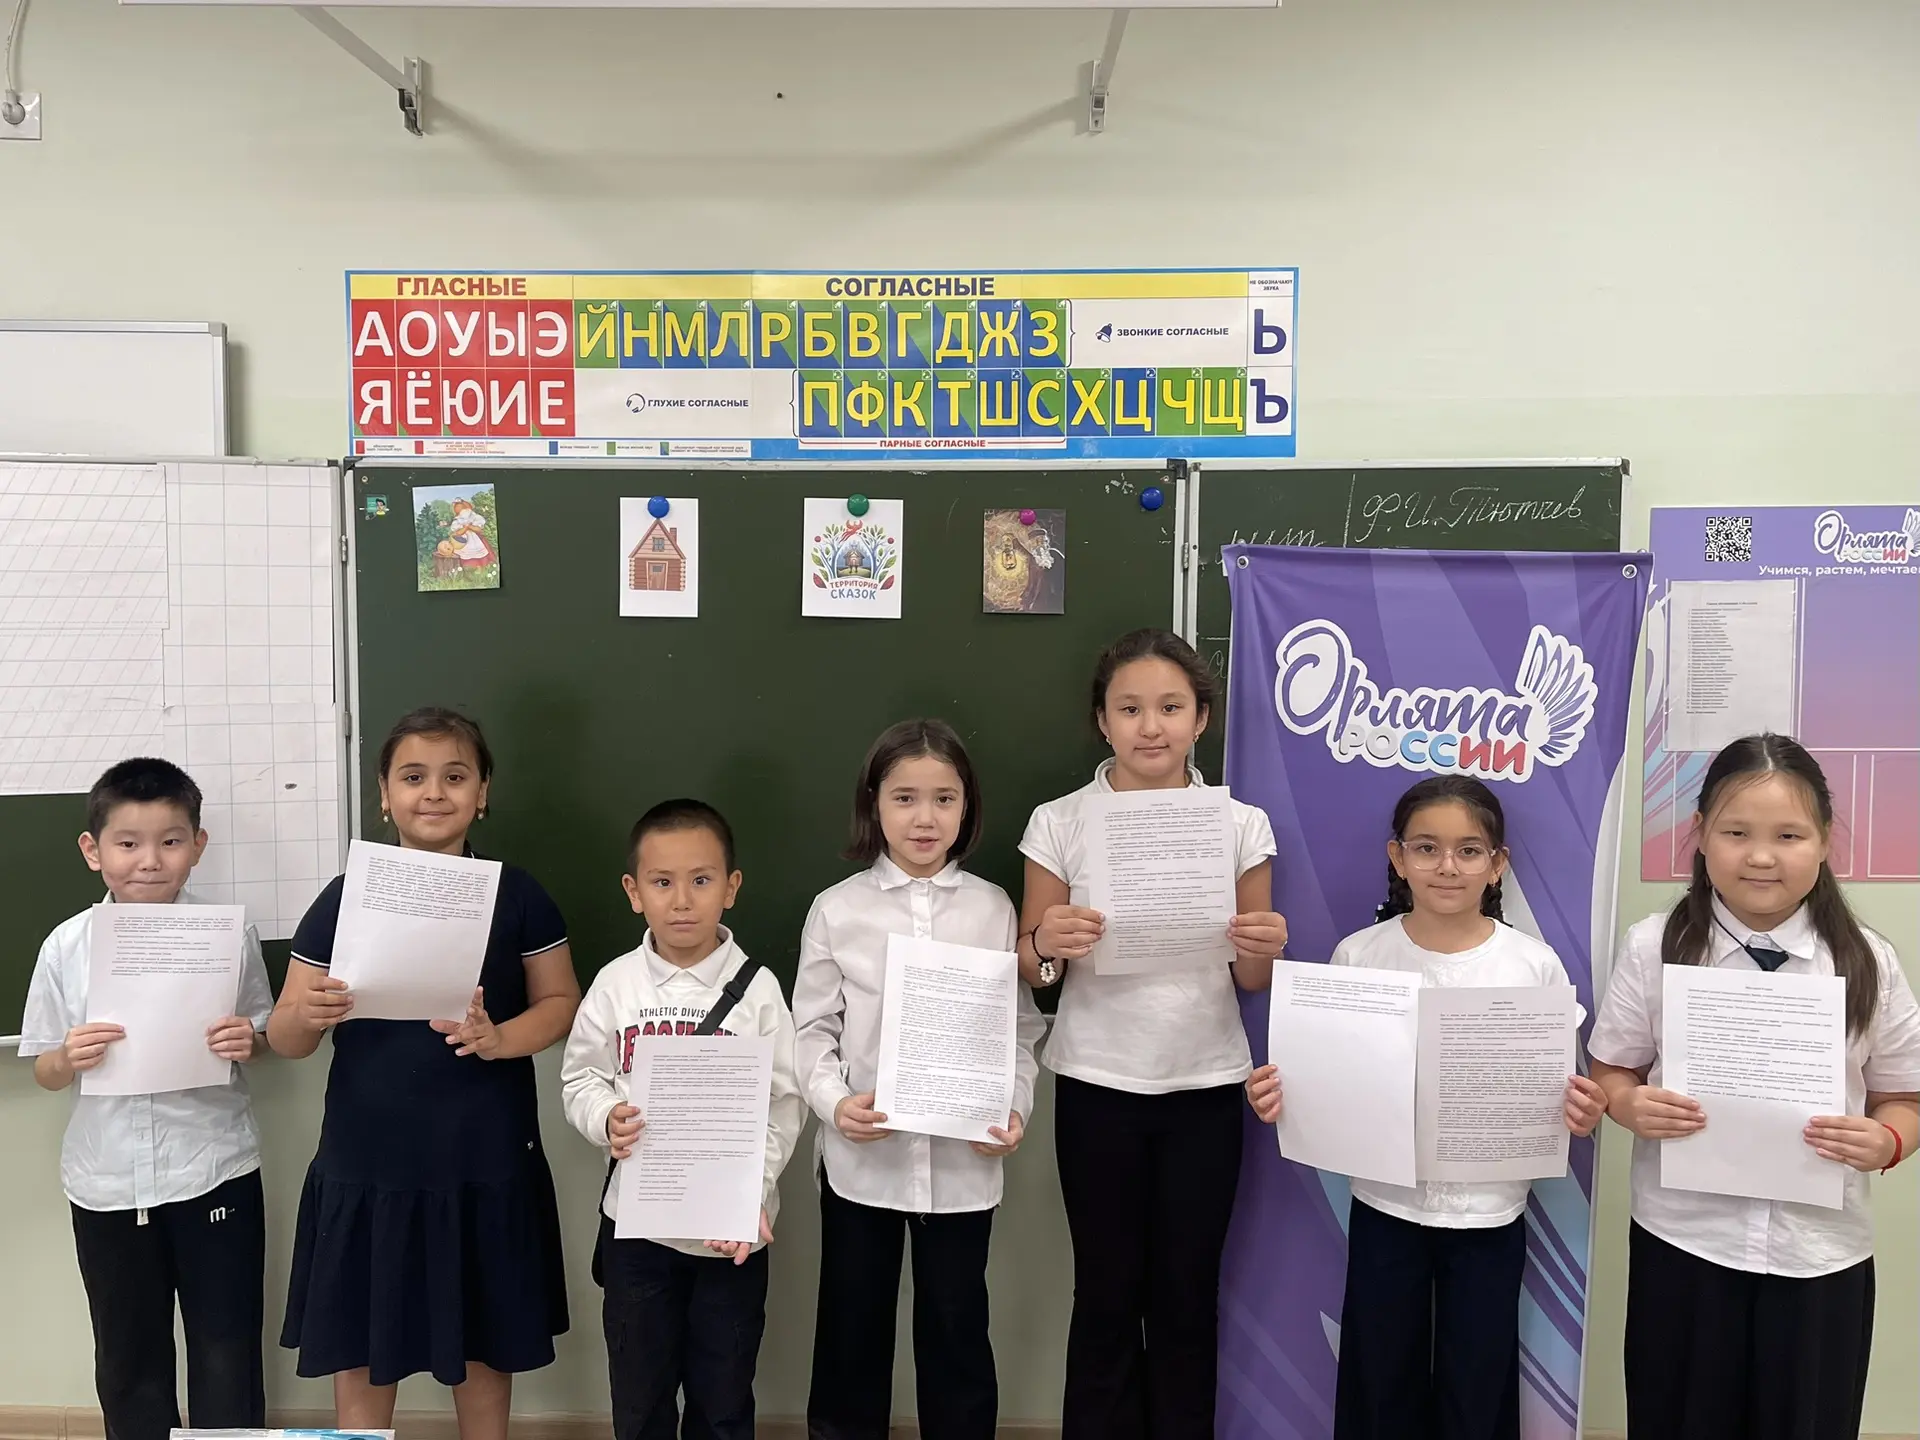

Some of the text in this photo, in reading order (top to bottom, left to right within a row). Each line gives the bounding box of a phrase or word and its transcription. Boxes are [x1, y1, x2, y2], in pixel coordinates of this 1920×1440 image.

[397, 277, 526, 296] ГЛАСНЫЕ
[826, 277, 995, 297] СОГЛАСНЫЕ
[354, 311, 568, 358] А О У Ы Э
[579, 304, 1059, 363] Й Н М Л Р Б В Г Д Ж З
[1117, 327, 1229, 337] ЗВОНКИЕ СОГЛАСНЫЕ
[1253, 309, 1287, 355] Ь
[359, 370, 566, 426] Я Ё Ю И Е
[648, 399, 749, 407] ГЛУХИЕ СОГЛАСНЫЕ
[803, 378, 1243, 431] П Ф К Т Ш С Х Ц Ч Щ
[1250, 378, 1289, 424] Ъ
[1817, 513, 1909, 555] Орлята
[1839, 549, 1907, 561] РОССИИ
[830, 580, 878, 589] ТЕРРИТОРИЯ
[1759, 565, 1920, 577] Учимся, растем, мечтае
[830, 588, 876, 600] СКАЗОК
[1281, 626, 1532, 741] Орлята
[1338, 723, 1528, 776] РОССИИ
[640, 1006, 709, 1018] ATHLETIC DIVIS
